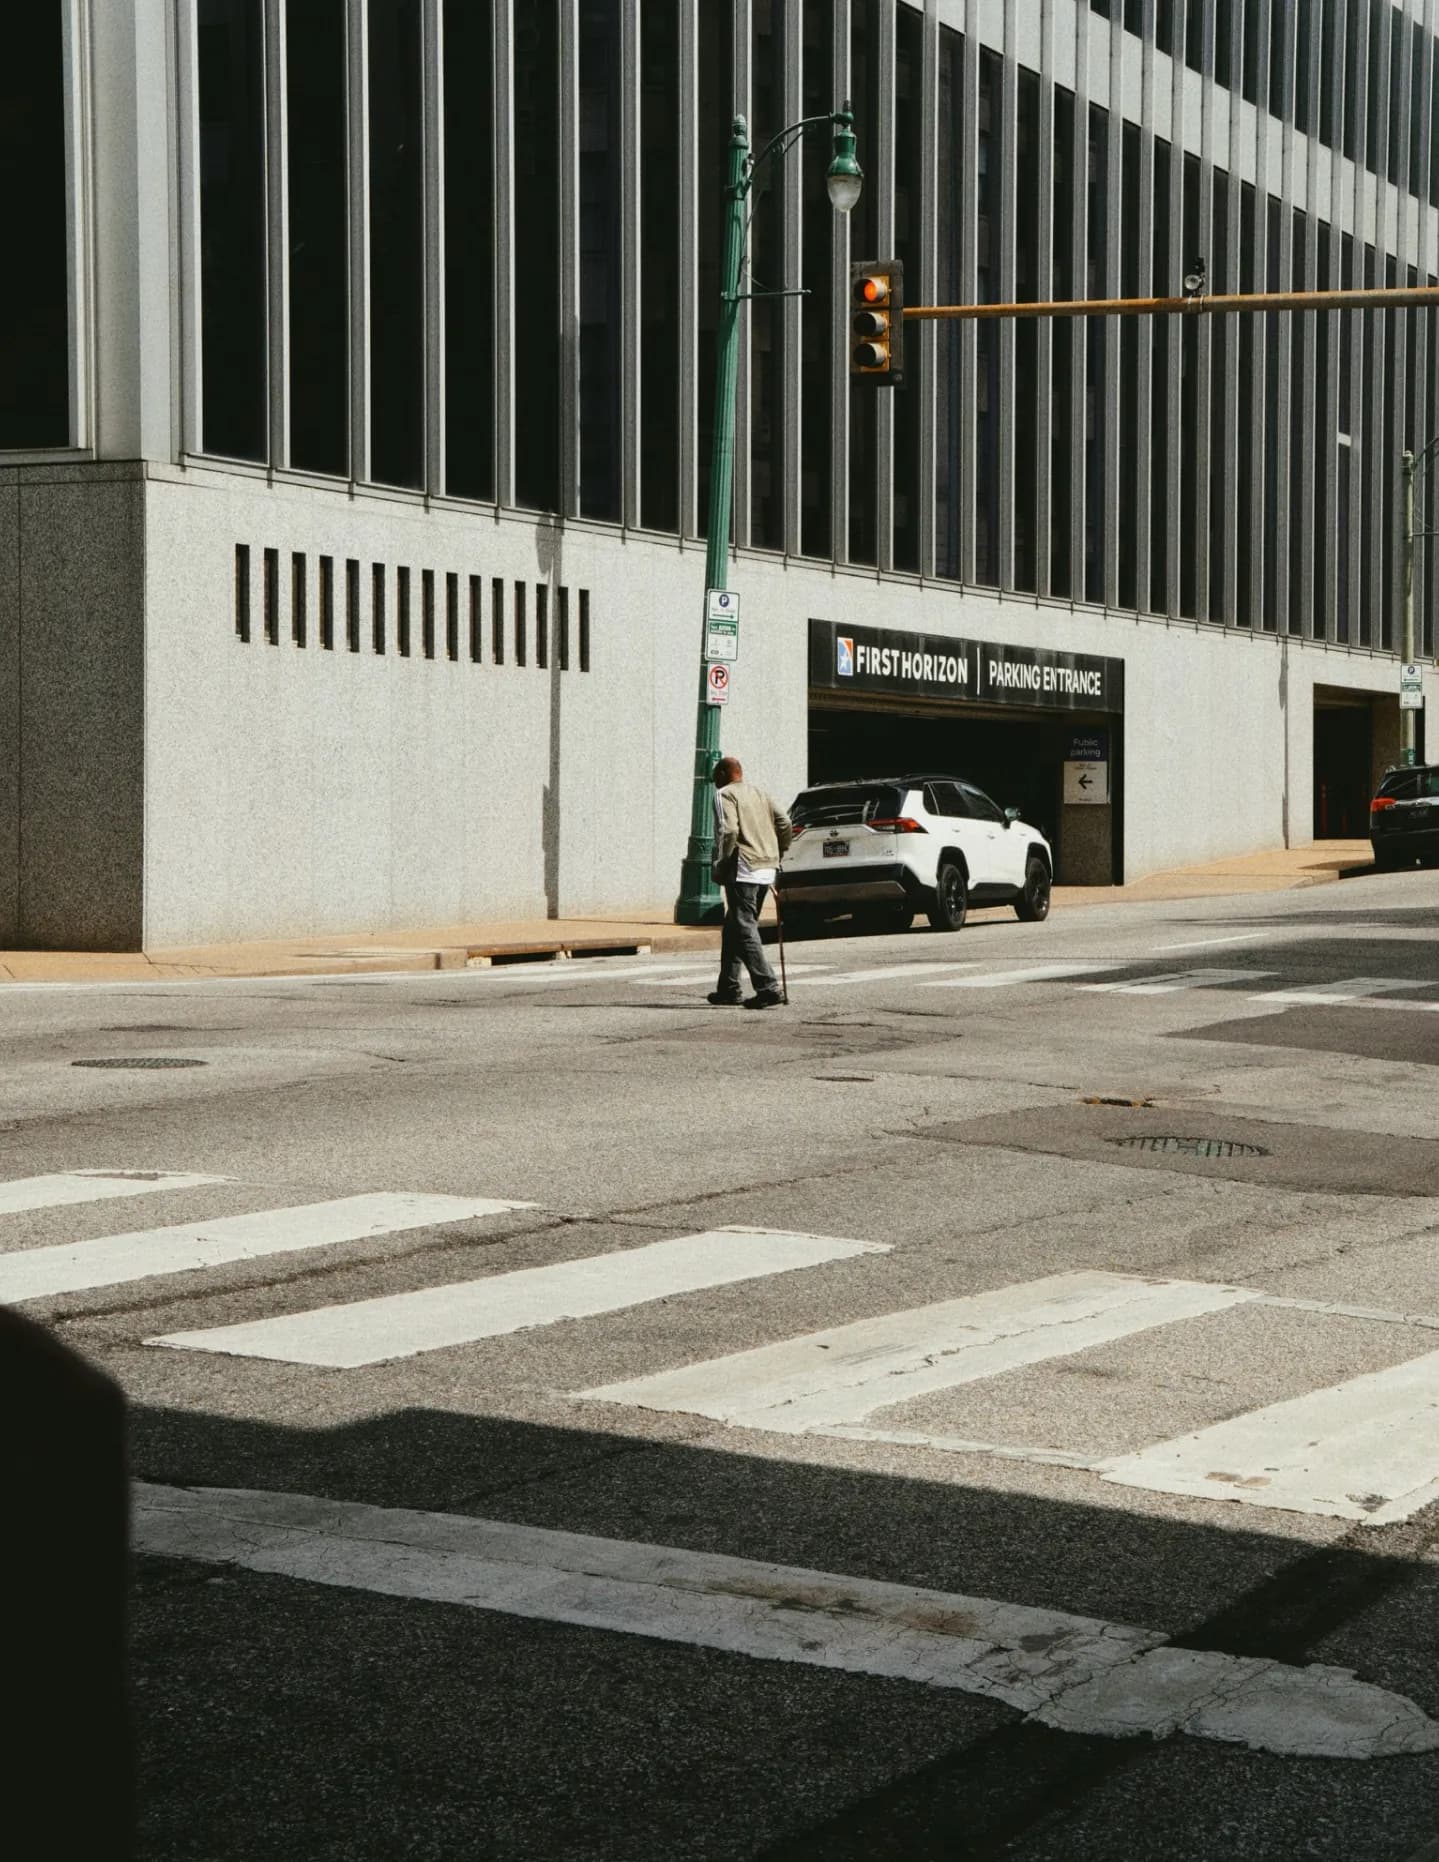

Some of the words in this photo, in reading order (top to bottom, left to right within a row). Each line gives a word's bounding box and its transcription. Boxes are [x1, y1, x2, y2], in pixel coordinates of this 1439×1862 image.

[856, 645, 900, 676] FIRST
[901, 652, 968, 684] HORIZON
[988, 660, 1041, 690] PARKING
[1042, 667, 1101, 696] ENTRANCE
